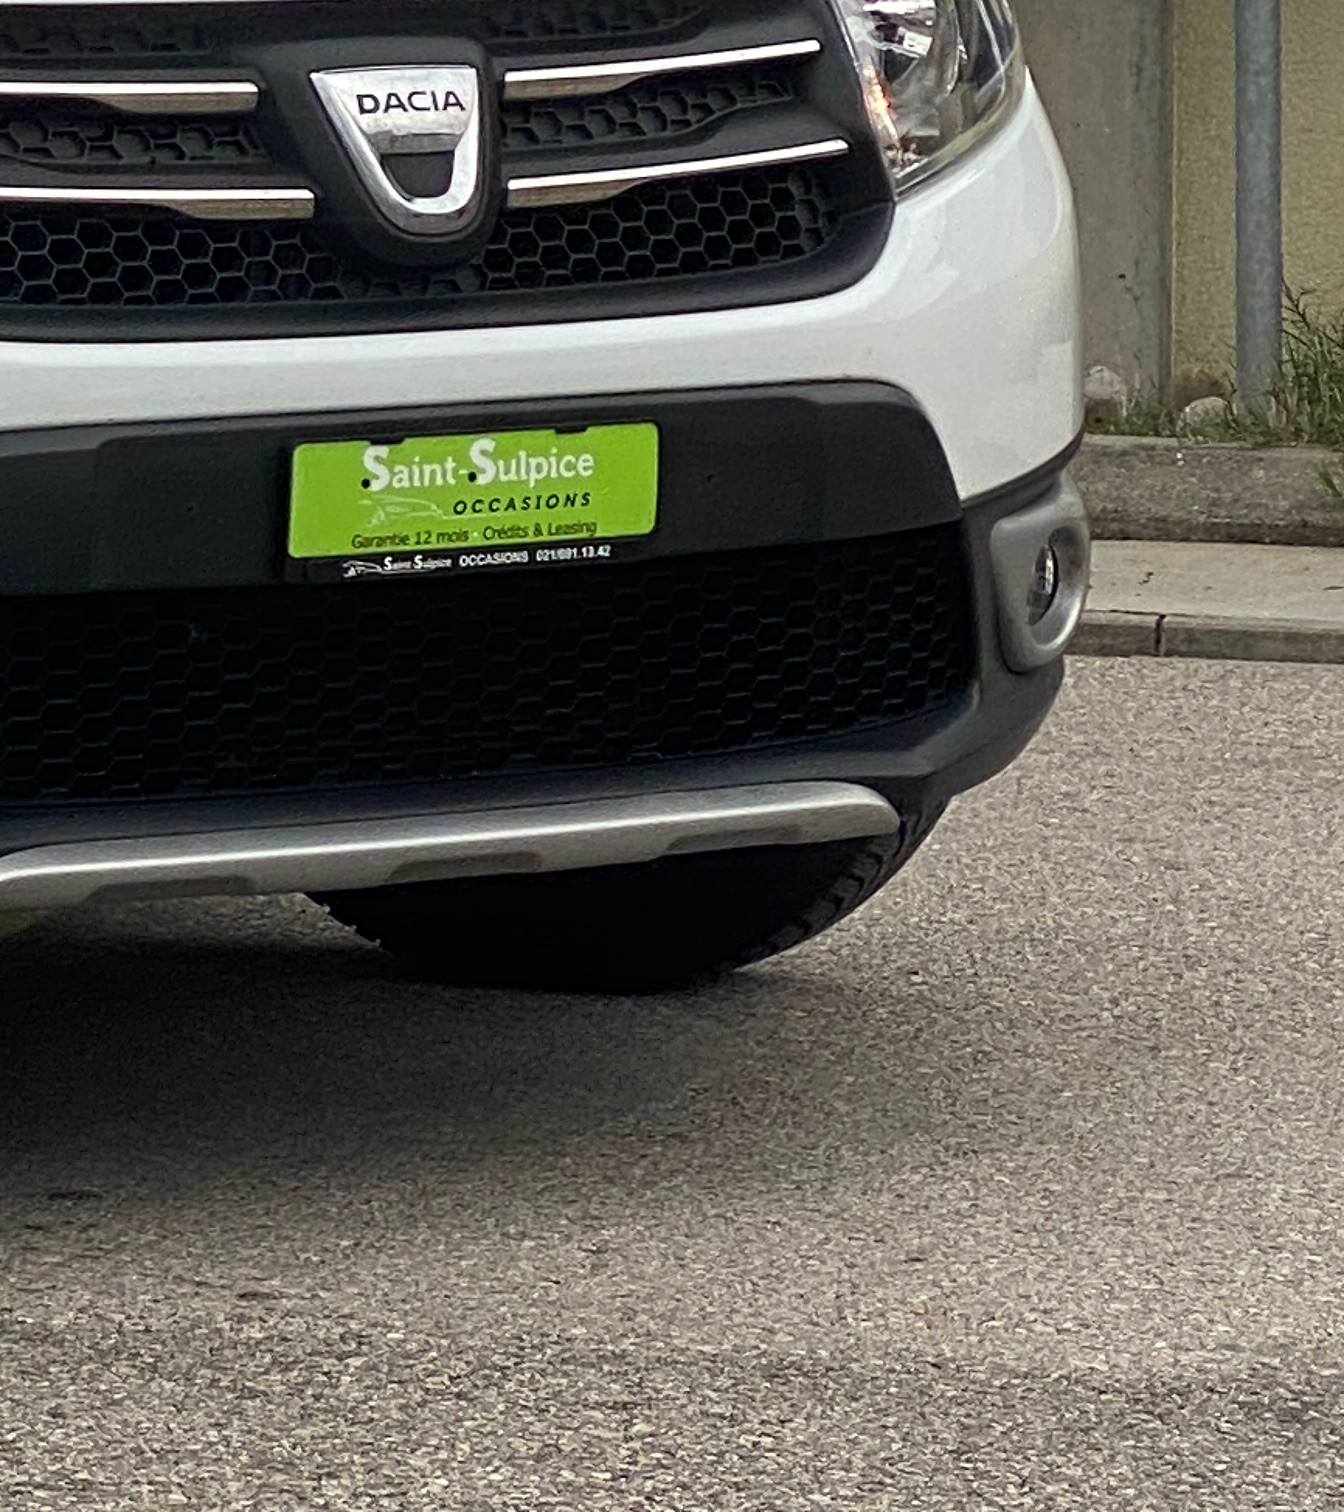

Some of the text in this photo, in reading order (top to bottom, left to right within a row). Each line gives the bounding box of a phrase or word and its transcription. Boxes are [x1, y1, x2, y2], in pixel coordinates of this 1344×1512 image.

[356, 90, 466, 115] DACIA
[453, 492, 591, 515] OCCASIONS
[351, 532, 410, 549] Garantie
[415, 531, 432, 545] 12
[436, 528, 469, 544] mois
[533, 522, 544, 537] &
[548, 520, 597, 538] Leasing
[459, 550, 528, 567] OCCASIONS
